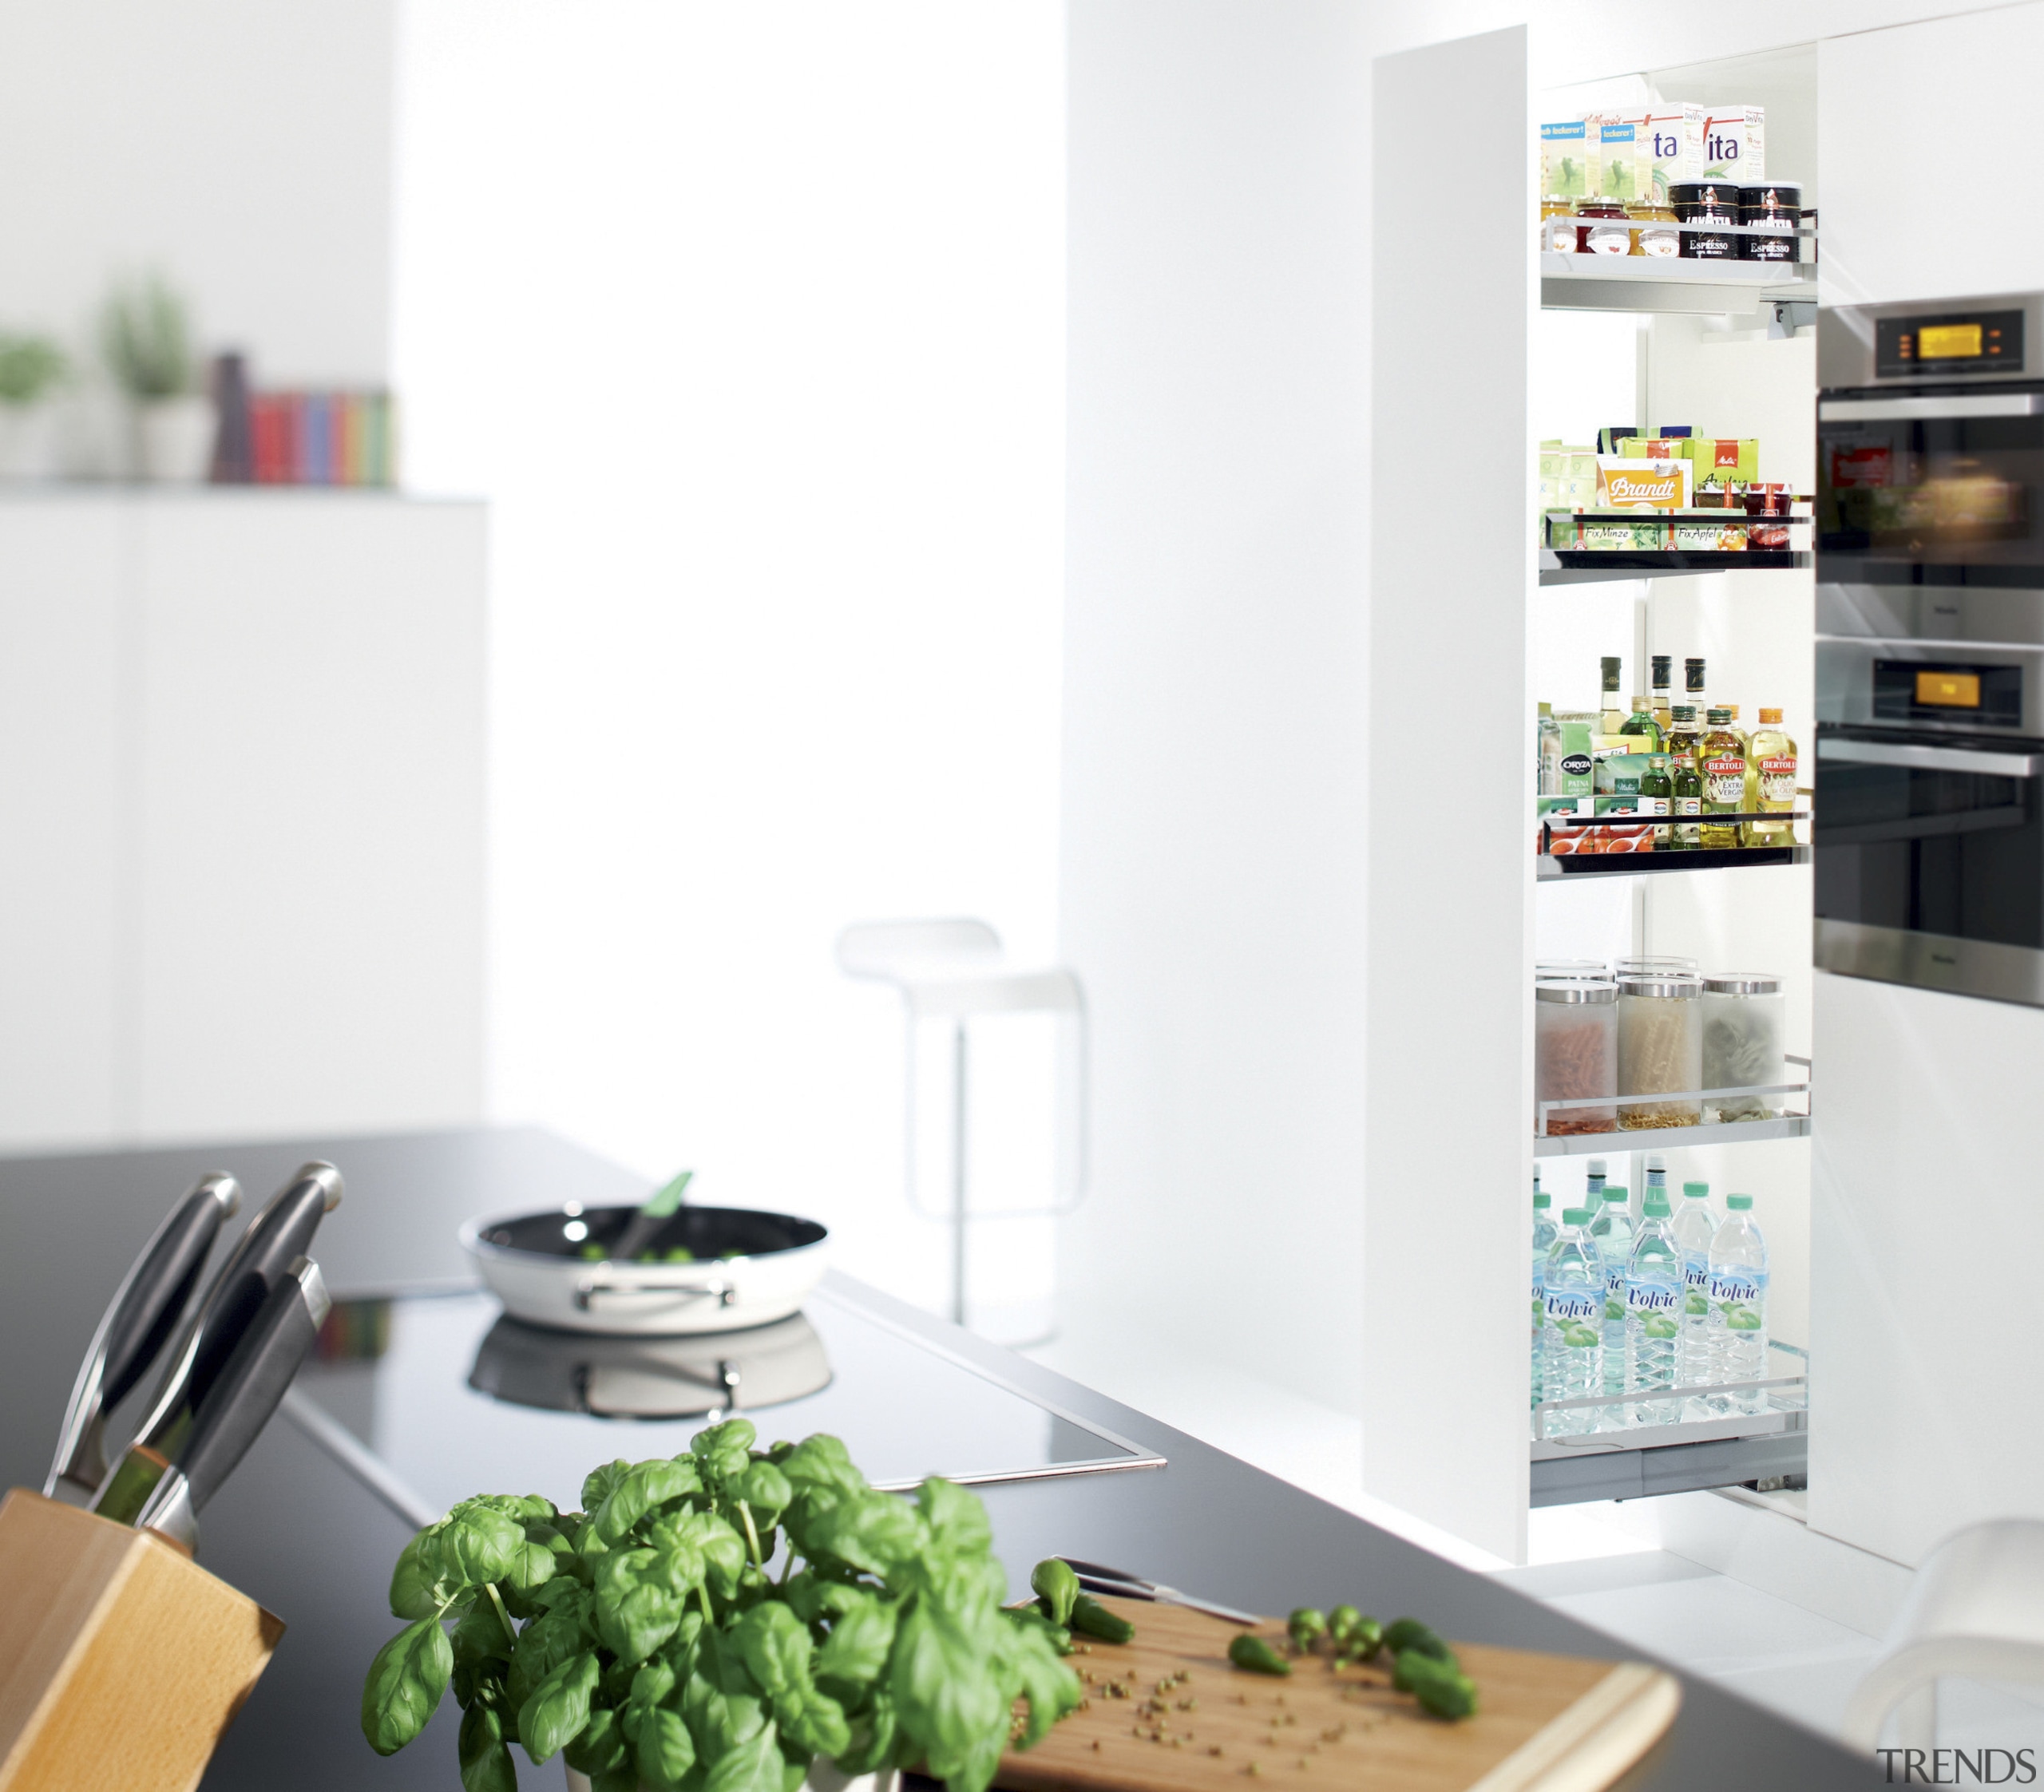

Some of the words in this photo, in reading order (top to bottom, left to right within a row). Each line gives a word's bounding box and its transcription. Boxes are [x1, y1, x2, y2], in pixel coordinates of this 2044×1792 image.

[1689, 239, 1728, 250] ESPRESSO
[1750, 243, 1790, 253] ESPRESSO
[1610, 477, 1675, 501] Brandt
[1563, 761, 1591, 769] ORYZA
[1629, 1288, 1677, 1309] Volvic
[1711, 1280, 1759, 1301] Volvic
[1548, 1298, 1597, 1318] Volvic
